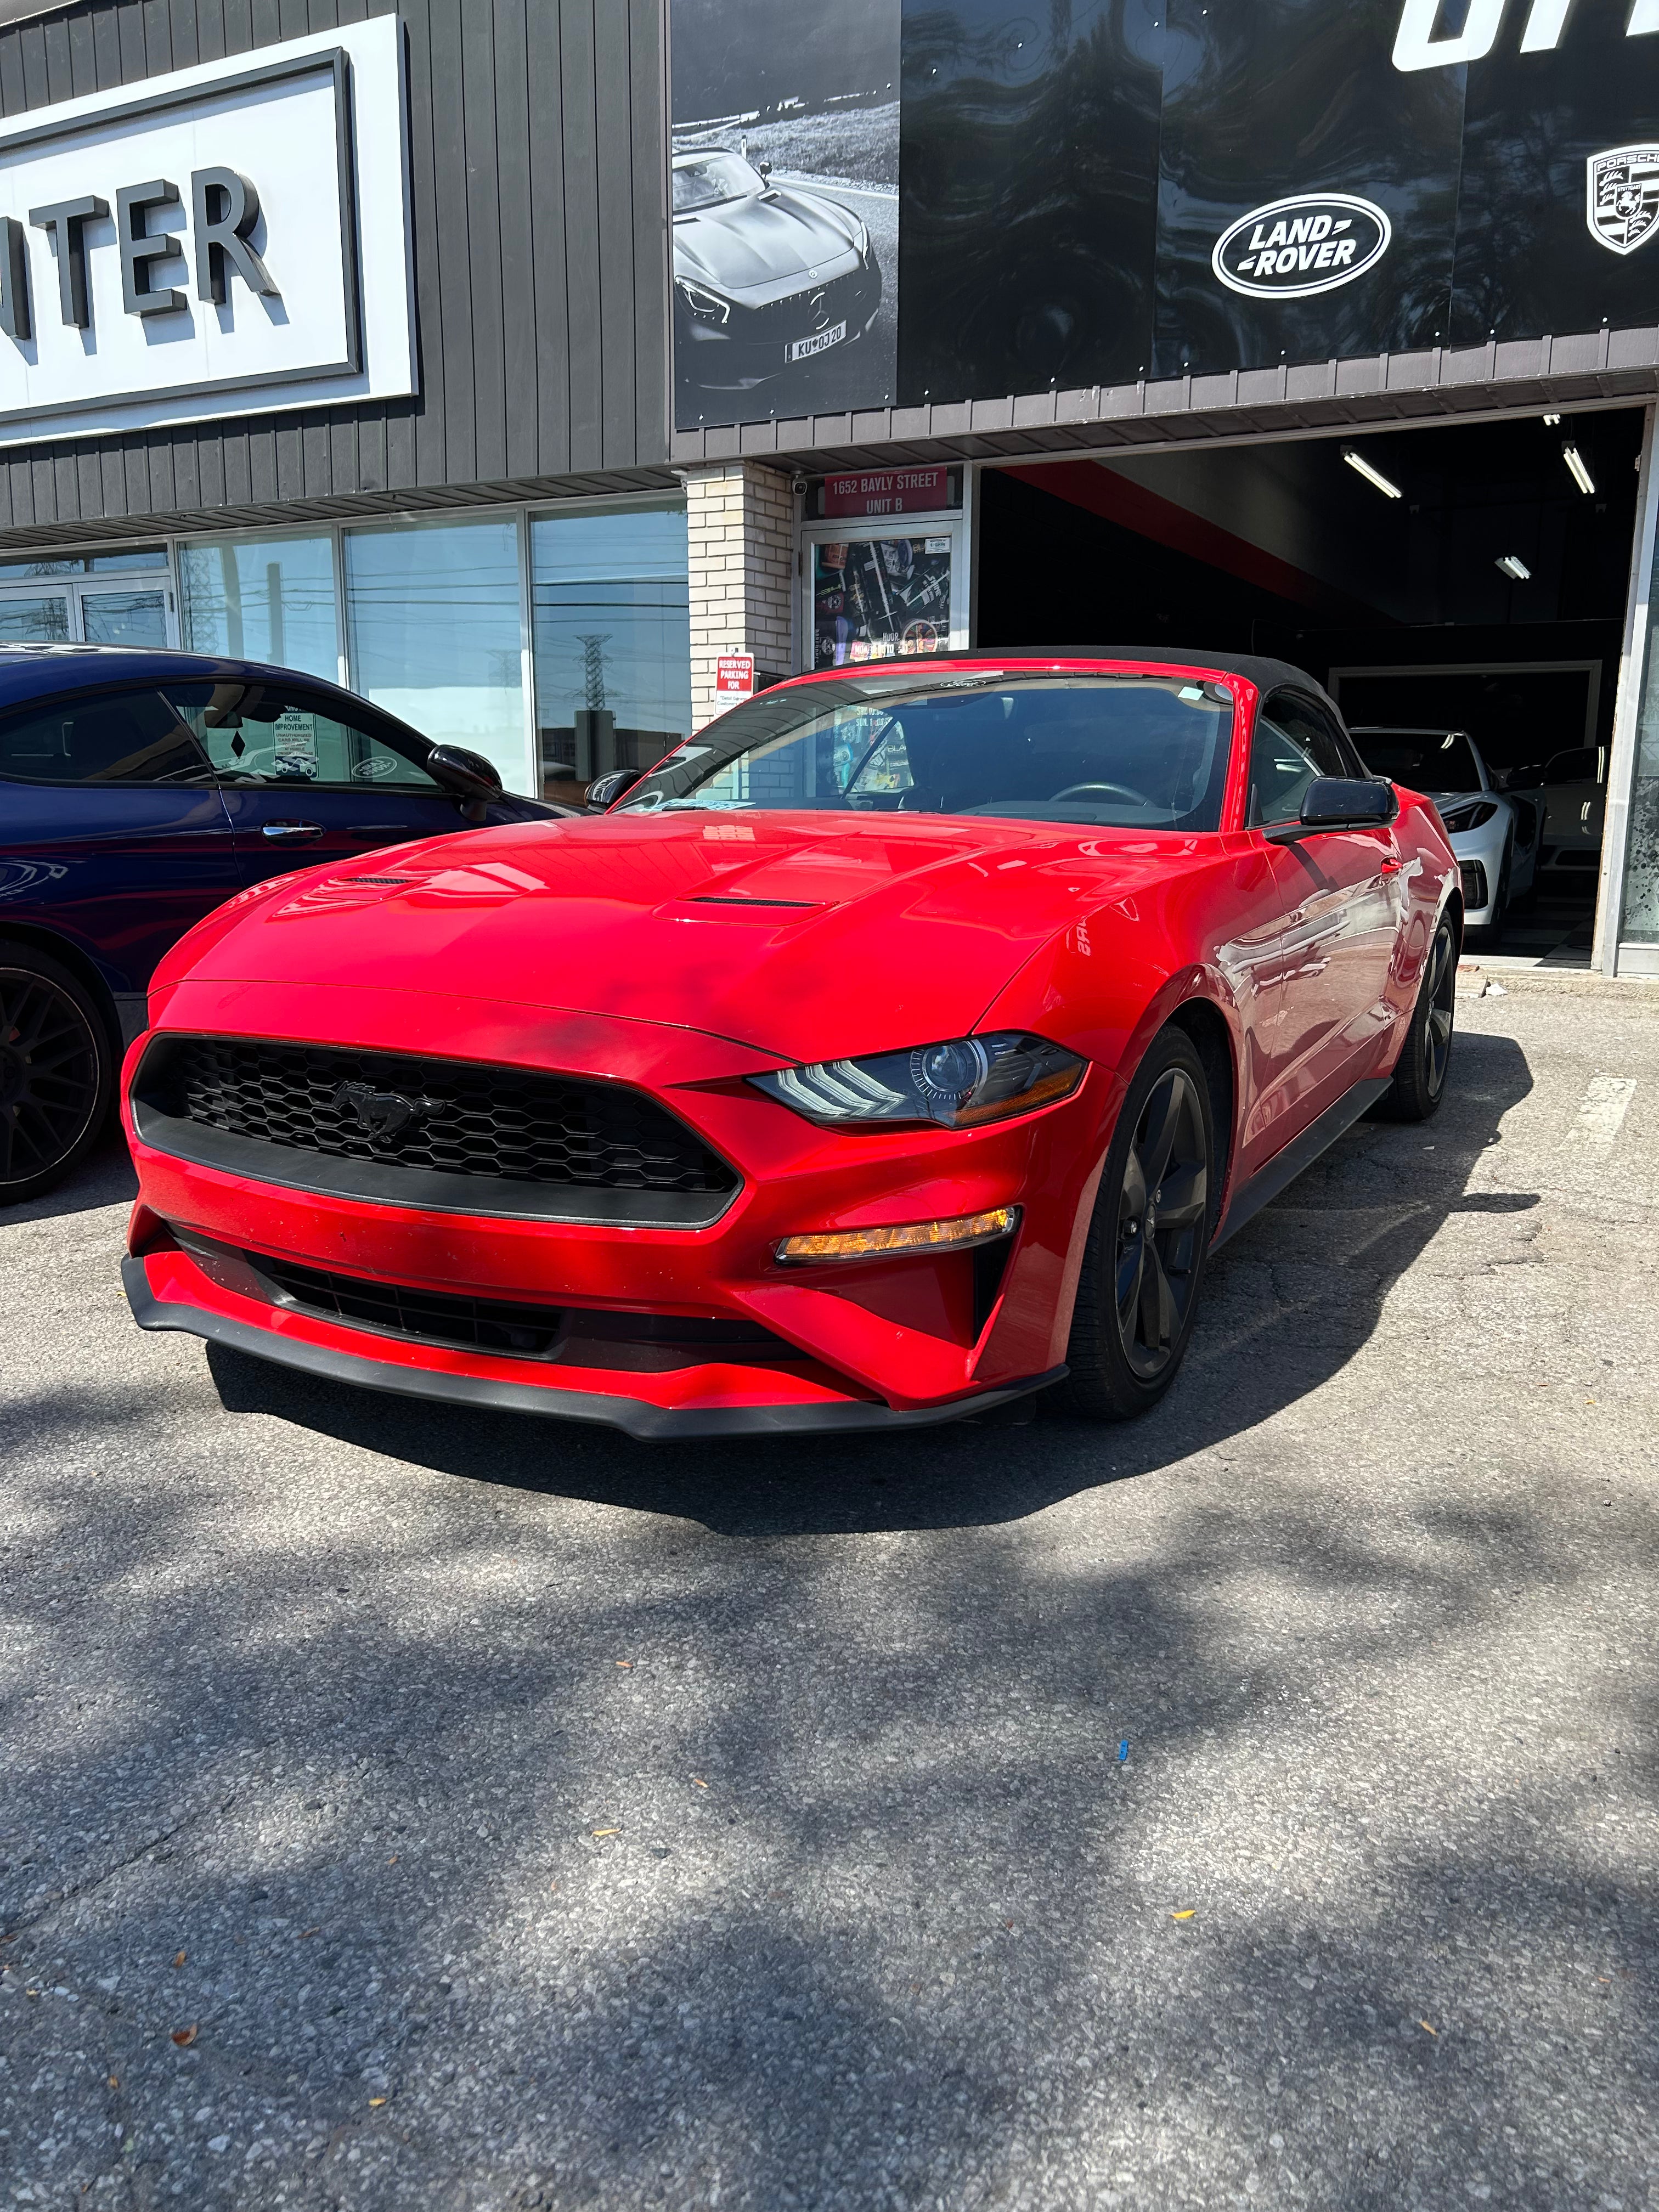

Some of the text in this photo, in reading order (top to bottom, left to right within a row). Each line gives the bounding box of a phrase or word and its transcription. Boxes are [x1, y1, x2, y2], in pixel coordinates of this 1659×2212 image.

[1597, 153, 1659, 172] PORSCH
[833, 472, 939, 495] 1652 BAYLY STREET
[866, 498, 903, 515] UNIT B
[719, 660, 751, 669] RESERVED
[720, 670, 749, 680] PARKING
[727, 680, 740, 690] FOR
